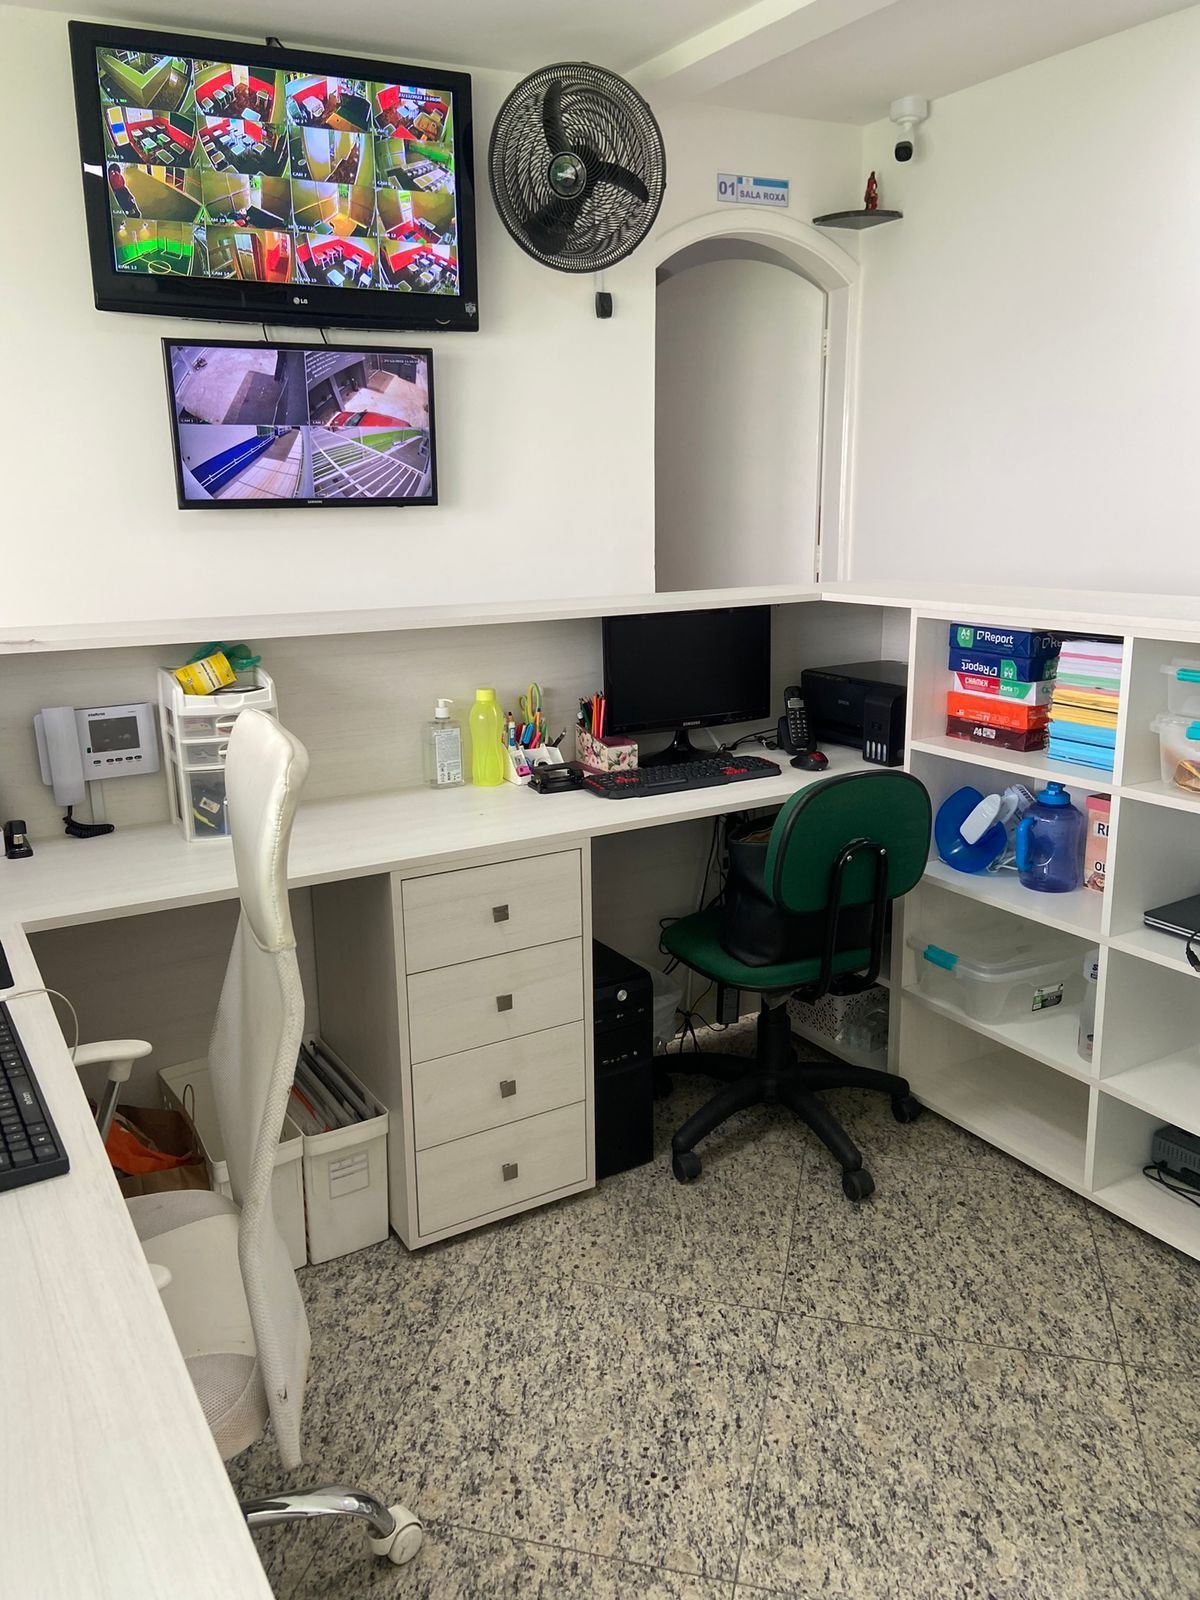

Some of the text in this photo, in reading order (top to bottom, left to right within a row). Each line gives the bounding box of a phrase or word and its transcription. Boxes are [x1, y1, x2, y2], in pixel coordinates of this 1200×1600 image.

[719, 181, 735, 196] 01
[740, 190, 786, 202] SALA ROXA
[984, 633, 1014, 644] Report
[961, 662, 990, 674] Report
[973, 727, 983, 737] A4
